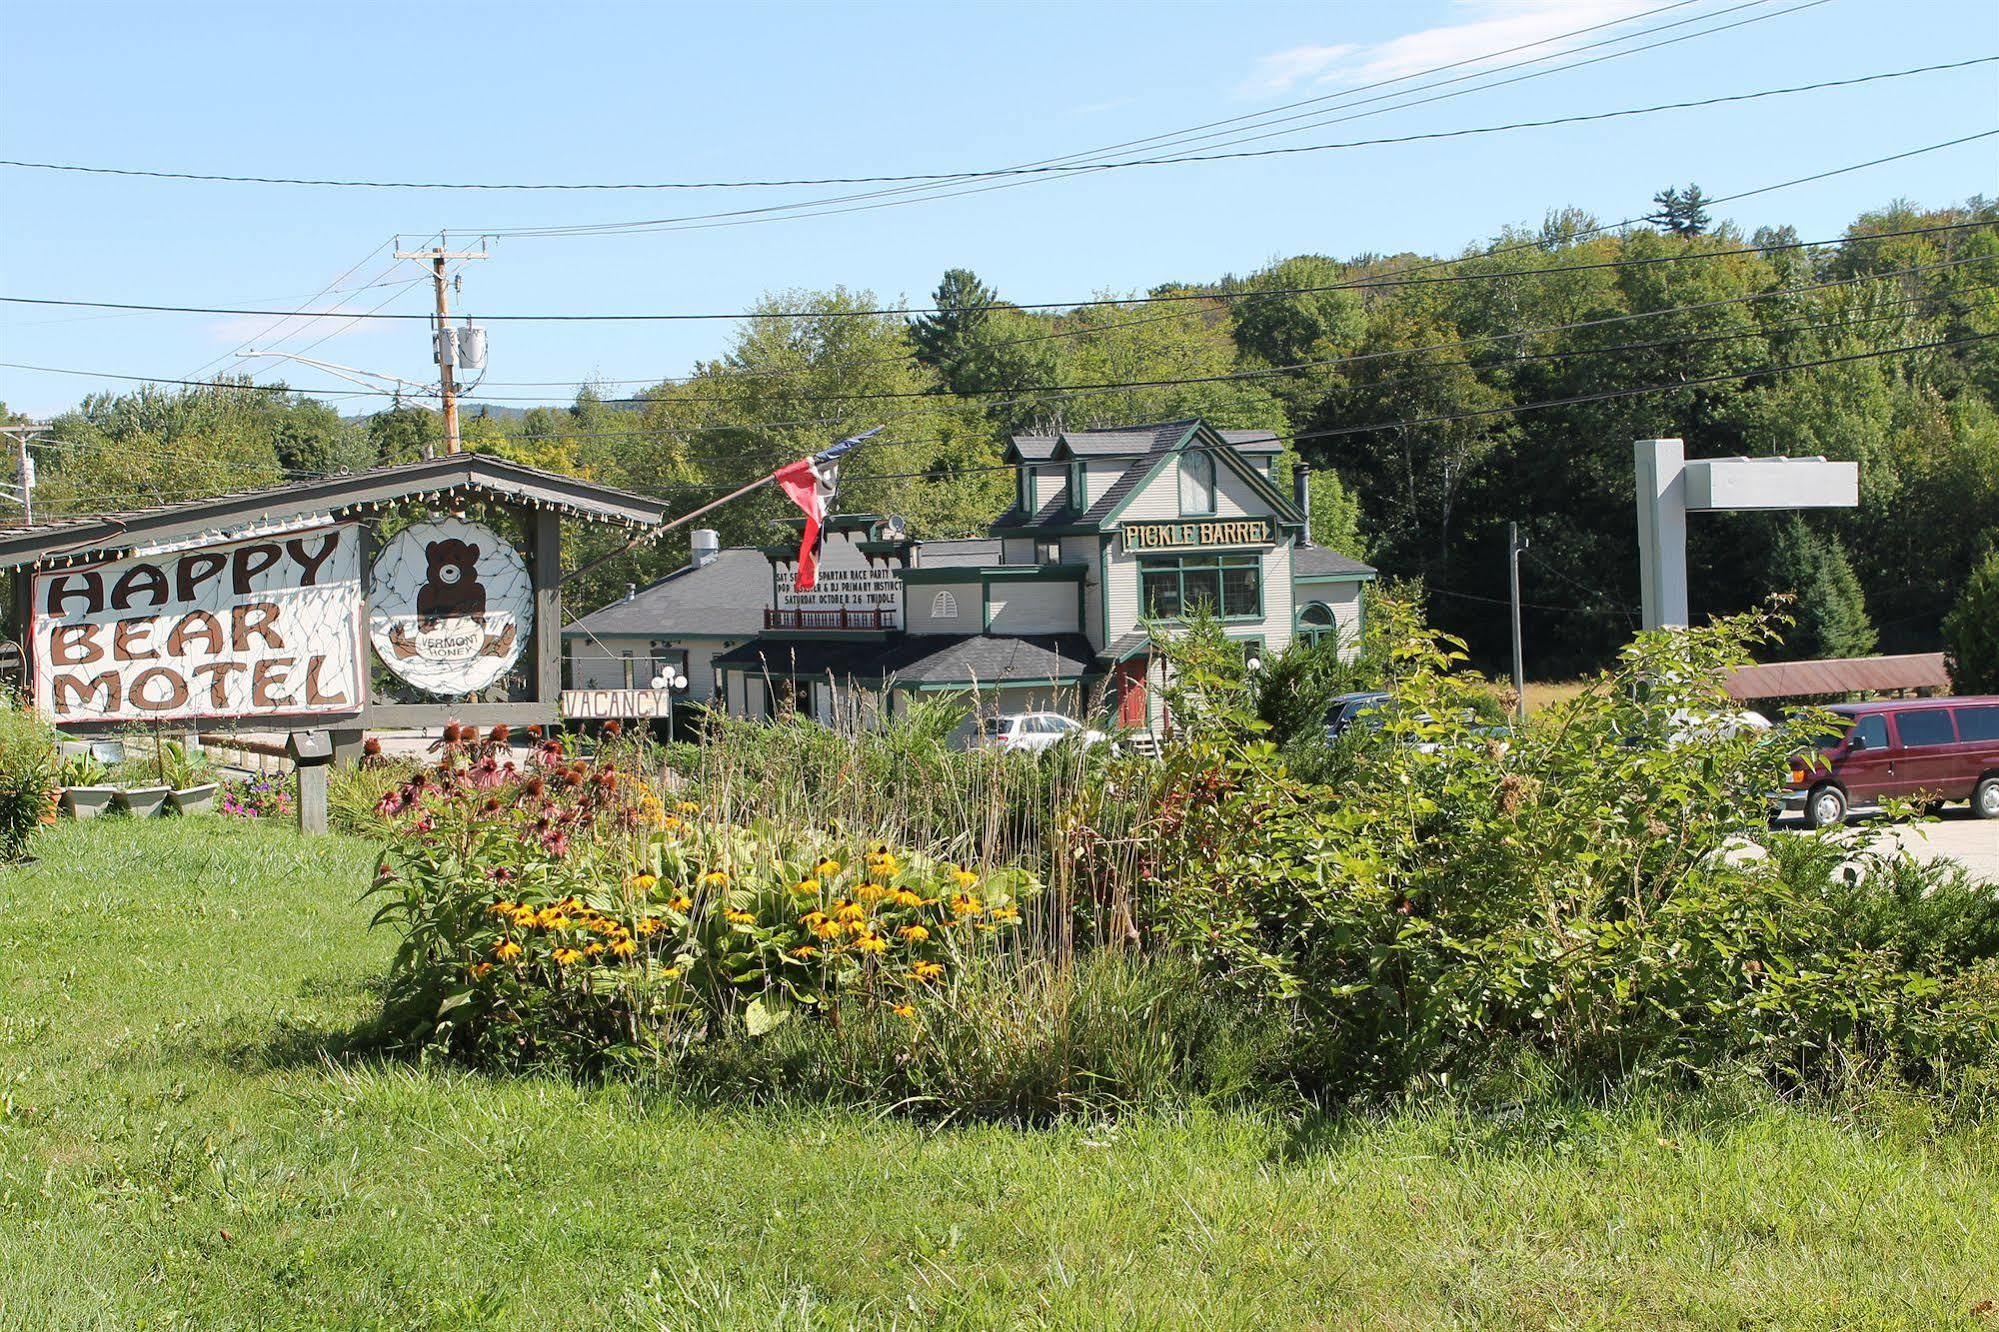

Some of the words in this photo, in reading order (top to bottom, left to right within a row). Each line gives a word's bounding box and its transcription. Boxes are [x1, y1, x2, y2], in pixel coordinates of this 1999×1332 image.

[1125, 524, 1197, 547] PICKLE
[1200, 521, 1272, 544] BARREL
[48, 531, 340, 618] HAPPY
[776, 573, 787, 582] SAT
[818, 571, 848, 581] SPARTAN
[850, 570, 867, 580] RACE
[870, 569, 889, 579] PARTY
[830, 582, 839, 592] DJ
[841, 582, 871, 592] PRIMARY
[873, 581, 903, 591] INSTINCT
[784, 595, 816, 604] SATURDAY
[818, 594, 849, 604] OCTOBER
[852, 594, 863, 604] 26
[867, 593, 895, 603] TWIDDLE
[50, 602, 285, 667] BEAR
[422, 634, 478, 648] VERMONT
[428, 646, 474, 657] HONEY
[53, 655, 348, 714] MOTEL
[566, 691, 663, 717] VACANCY
